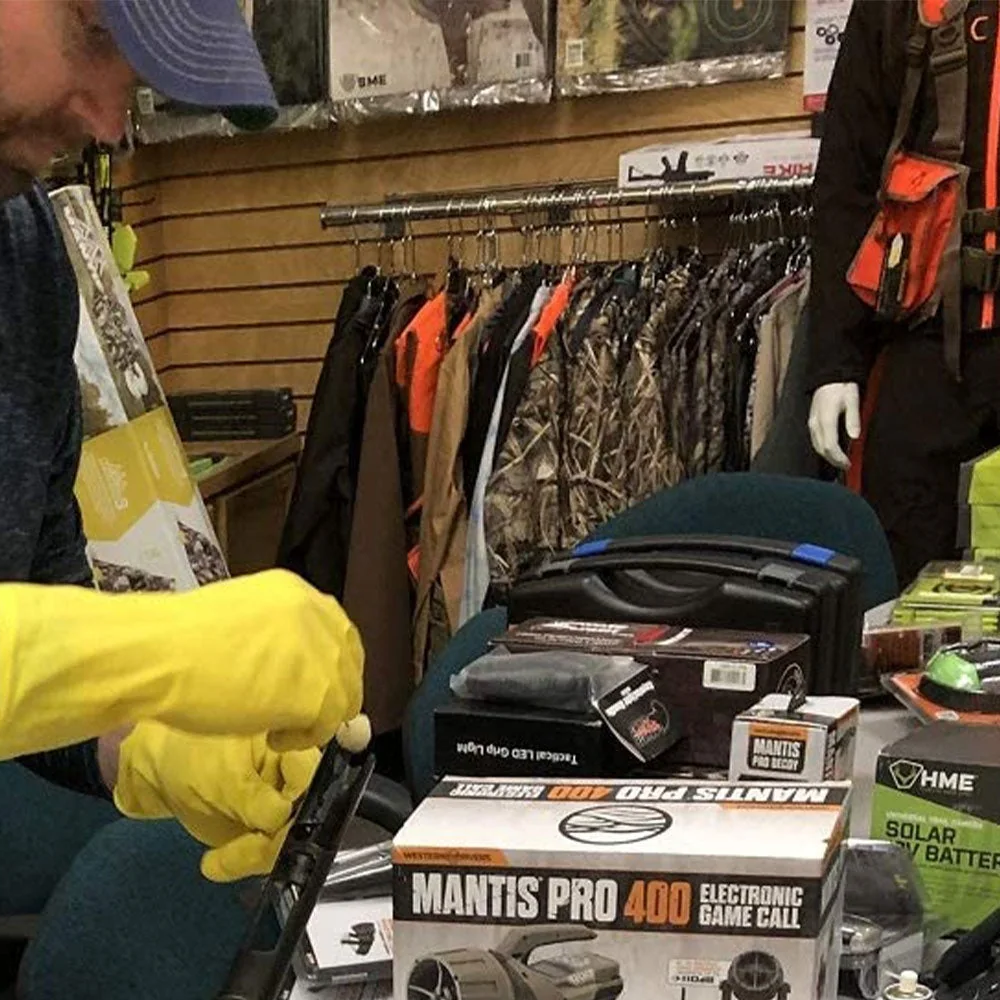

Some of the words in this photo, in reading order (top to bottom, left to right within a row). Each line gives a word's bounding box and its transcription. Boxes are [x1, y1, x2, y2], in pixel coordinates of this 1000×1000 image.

[357, 74, 386, 88] SME
[456, 743, 483, 759] Light
[485, 746, 509, 760] Grip
[511, 749, 535, 762] LED
[753, 739, 800, 759] MANTIS
[536, 750, 579, 766] Tactical
[921, 770, 975, 791] HME
[547, 783, 612, 801] 400
[615, 785, 687, 801] PRO
[694, 787, 829, 803] MANTIS
[886, 821, 956, 845] SOLAR
[412, 872, 539, 919] MANTIS
[547, 879, 617, 922] PRO
[623, 880, 691, 925] 400
[700, 883, 803, 908] ELECTRONIC
[699, 904, 752, 927] GAME
[757, 907, 801, 929] CALL
